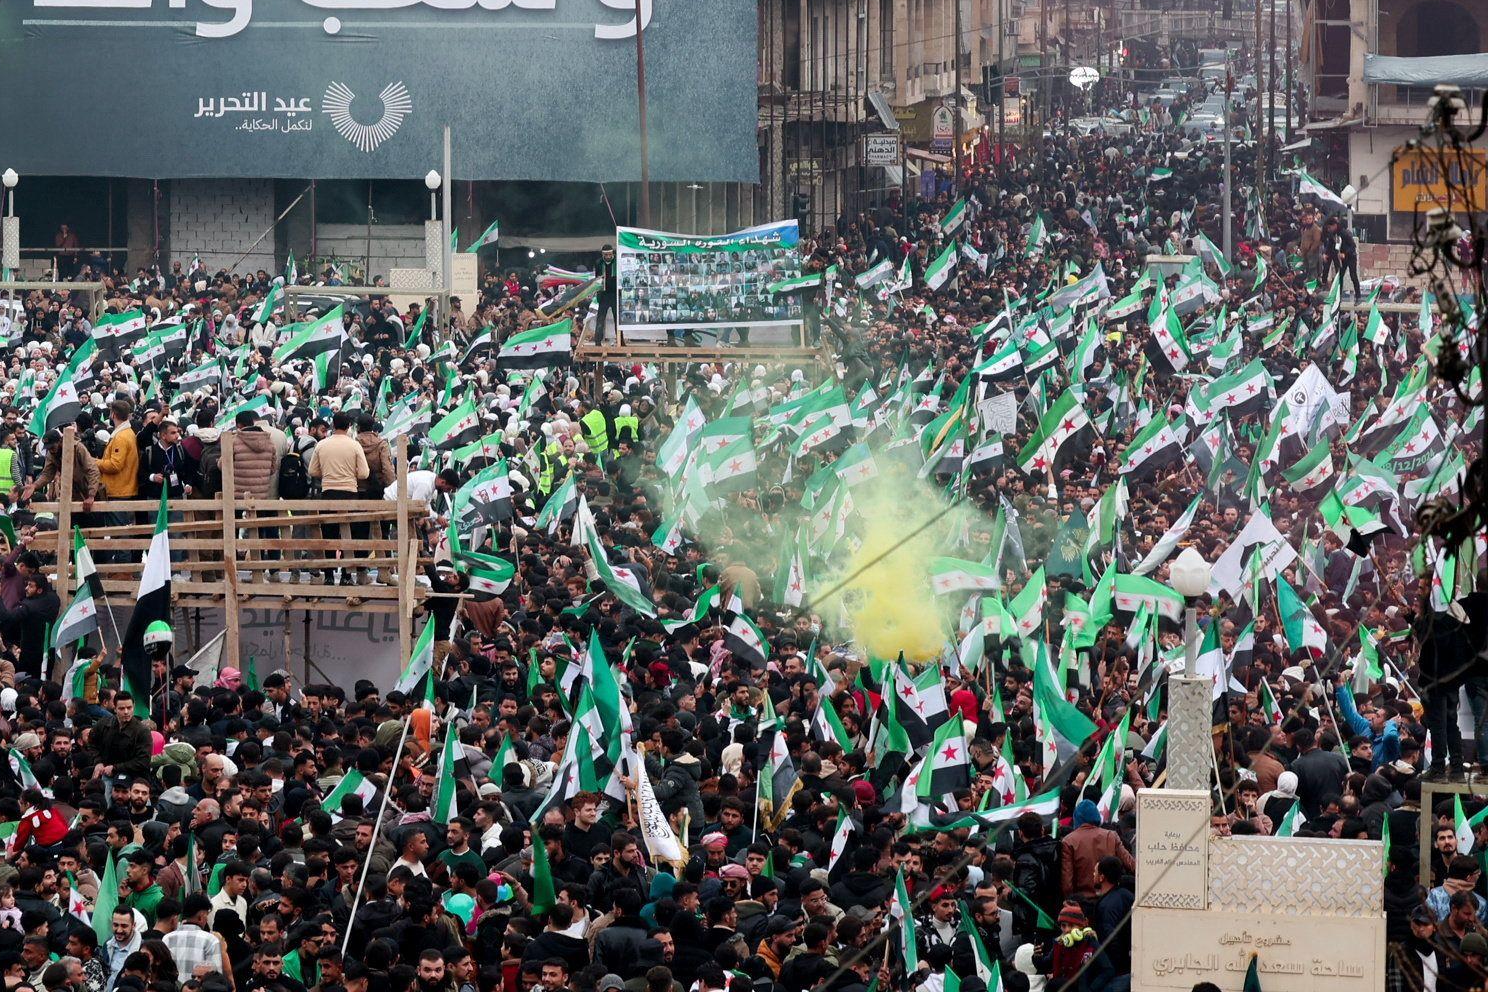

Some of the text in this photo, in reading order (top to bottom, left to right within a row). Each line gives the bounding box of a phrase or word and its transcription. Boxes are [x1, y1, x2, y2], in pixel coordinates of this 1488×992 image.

[194, 91, 312, 118] عيد التحرير
[281, 119, 312, 133] لنكمل
[637, 236, 691, 250] السورية
[738, 231, 781, 246] شهداء
[1147, 842, 1200, 852] محافظ حلب
[1218, 931, 1292, 947] مشروع تأهيل
[1153, 953, 1220, 978] الجابري
[1260, 961, 1304, 974] سعد
